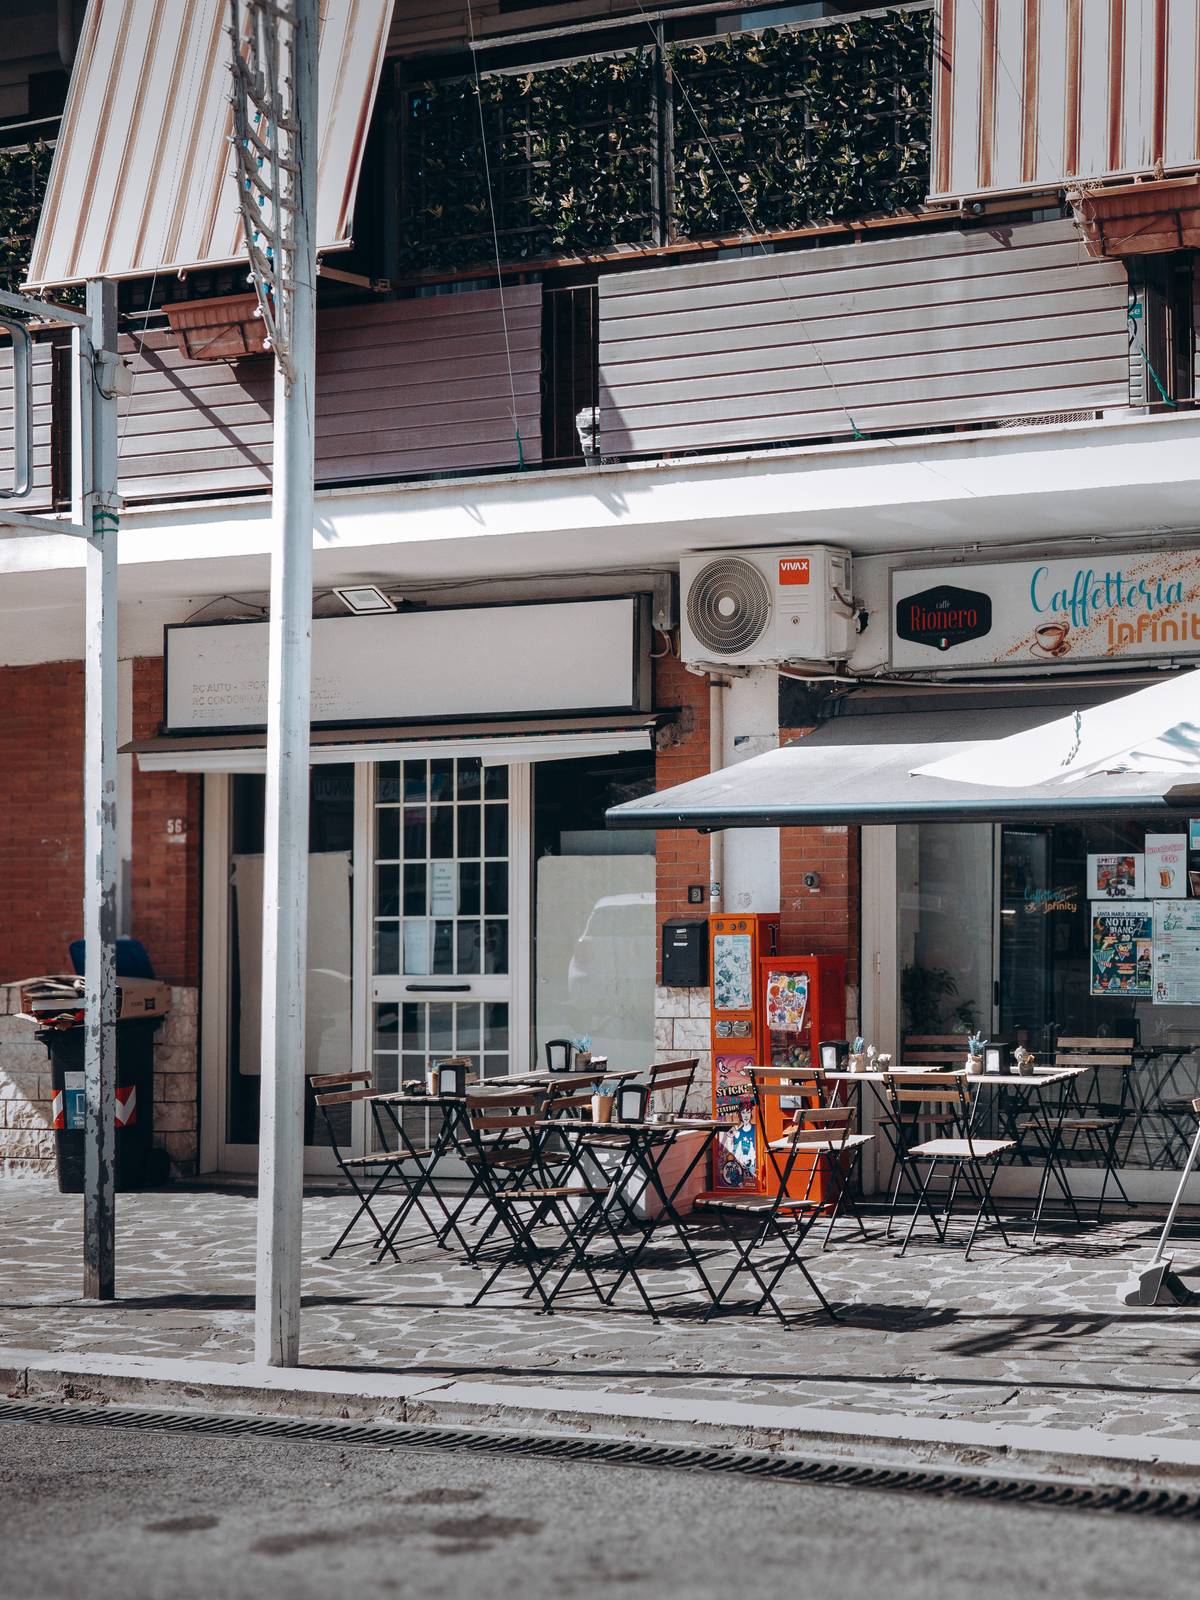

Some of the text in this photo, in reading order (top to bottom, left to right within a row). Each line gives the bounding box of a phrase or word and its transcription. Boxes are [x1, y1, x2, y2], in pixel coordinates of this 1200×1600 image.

[780, 562, 808, 571] VIVAX
[1030, 566, 1183, 628] Caffetteria
[911, 605, 977, 632] Rionero
[167, 819, 182, 833] 56
[1106, 888, 1126, 898] 4,00
[1045, 901, 1077, 913] Infinity
[1105, 918, 1136, 927] NOTTE
